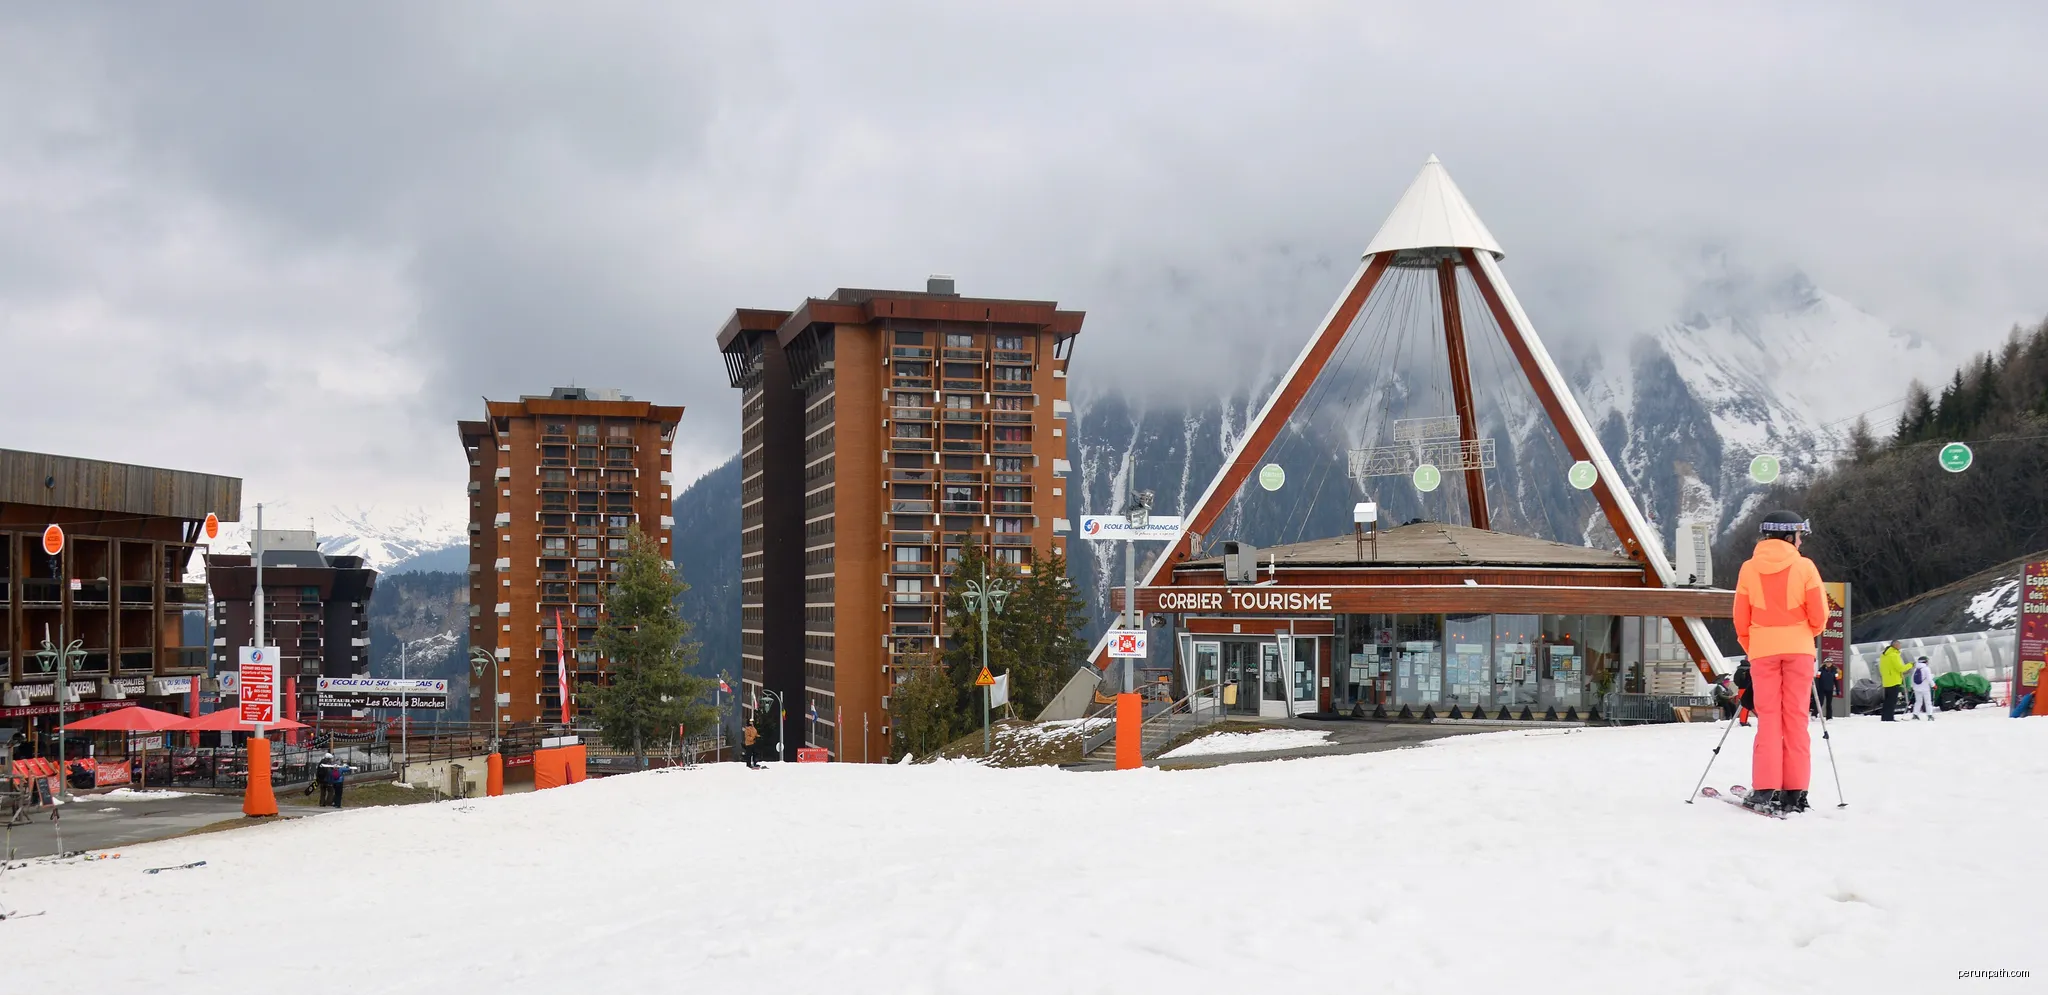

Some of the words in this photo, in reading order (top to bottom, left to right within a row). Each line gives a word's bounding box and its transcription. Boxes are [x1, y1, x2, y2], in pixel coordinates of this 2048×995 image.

[1761, 463, 1768, 472] 3
[1424, 472, 1431, 481] 1
[1580, 469, 1587, 478] 2
[2026, 575, 2048, 586] Espa
[2029, 591, 2043, 600] des
[1159, 592, 1223, 610] CORBIER
[1232, 592, 1332, 610] TOURISME
[366, 697, 380, 706] Les
[382, 697, 408, 707] Rochs
[411, 698, 445, 707] Blanches
[49, 703, 76, 712] BLACHES
